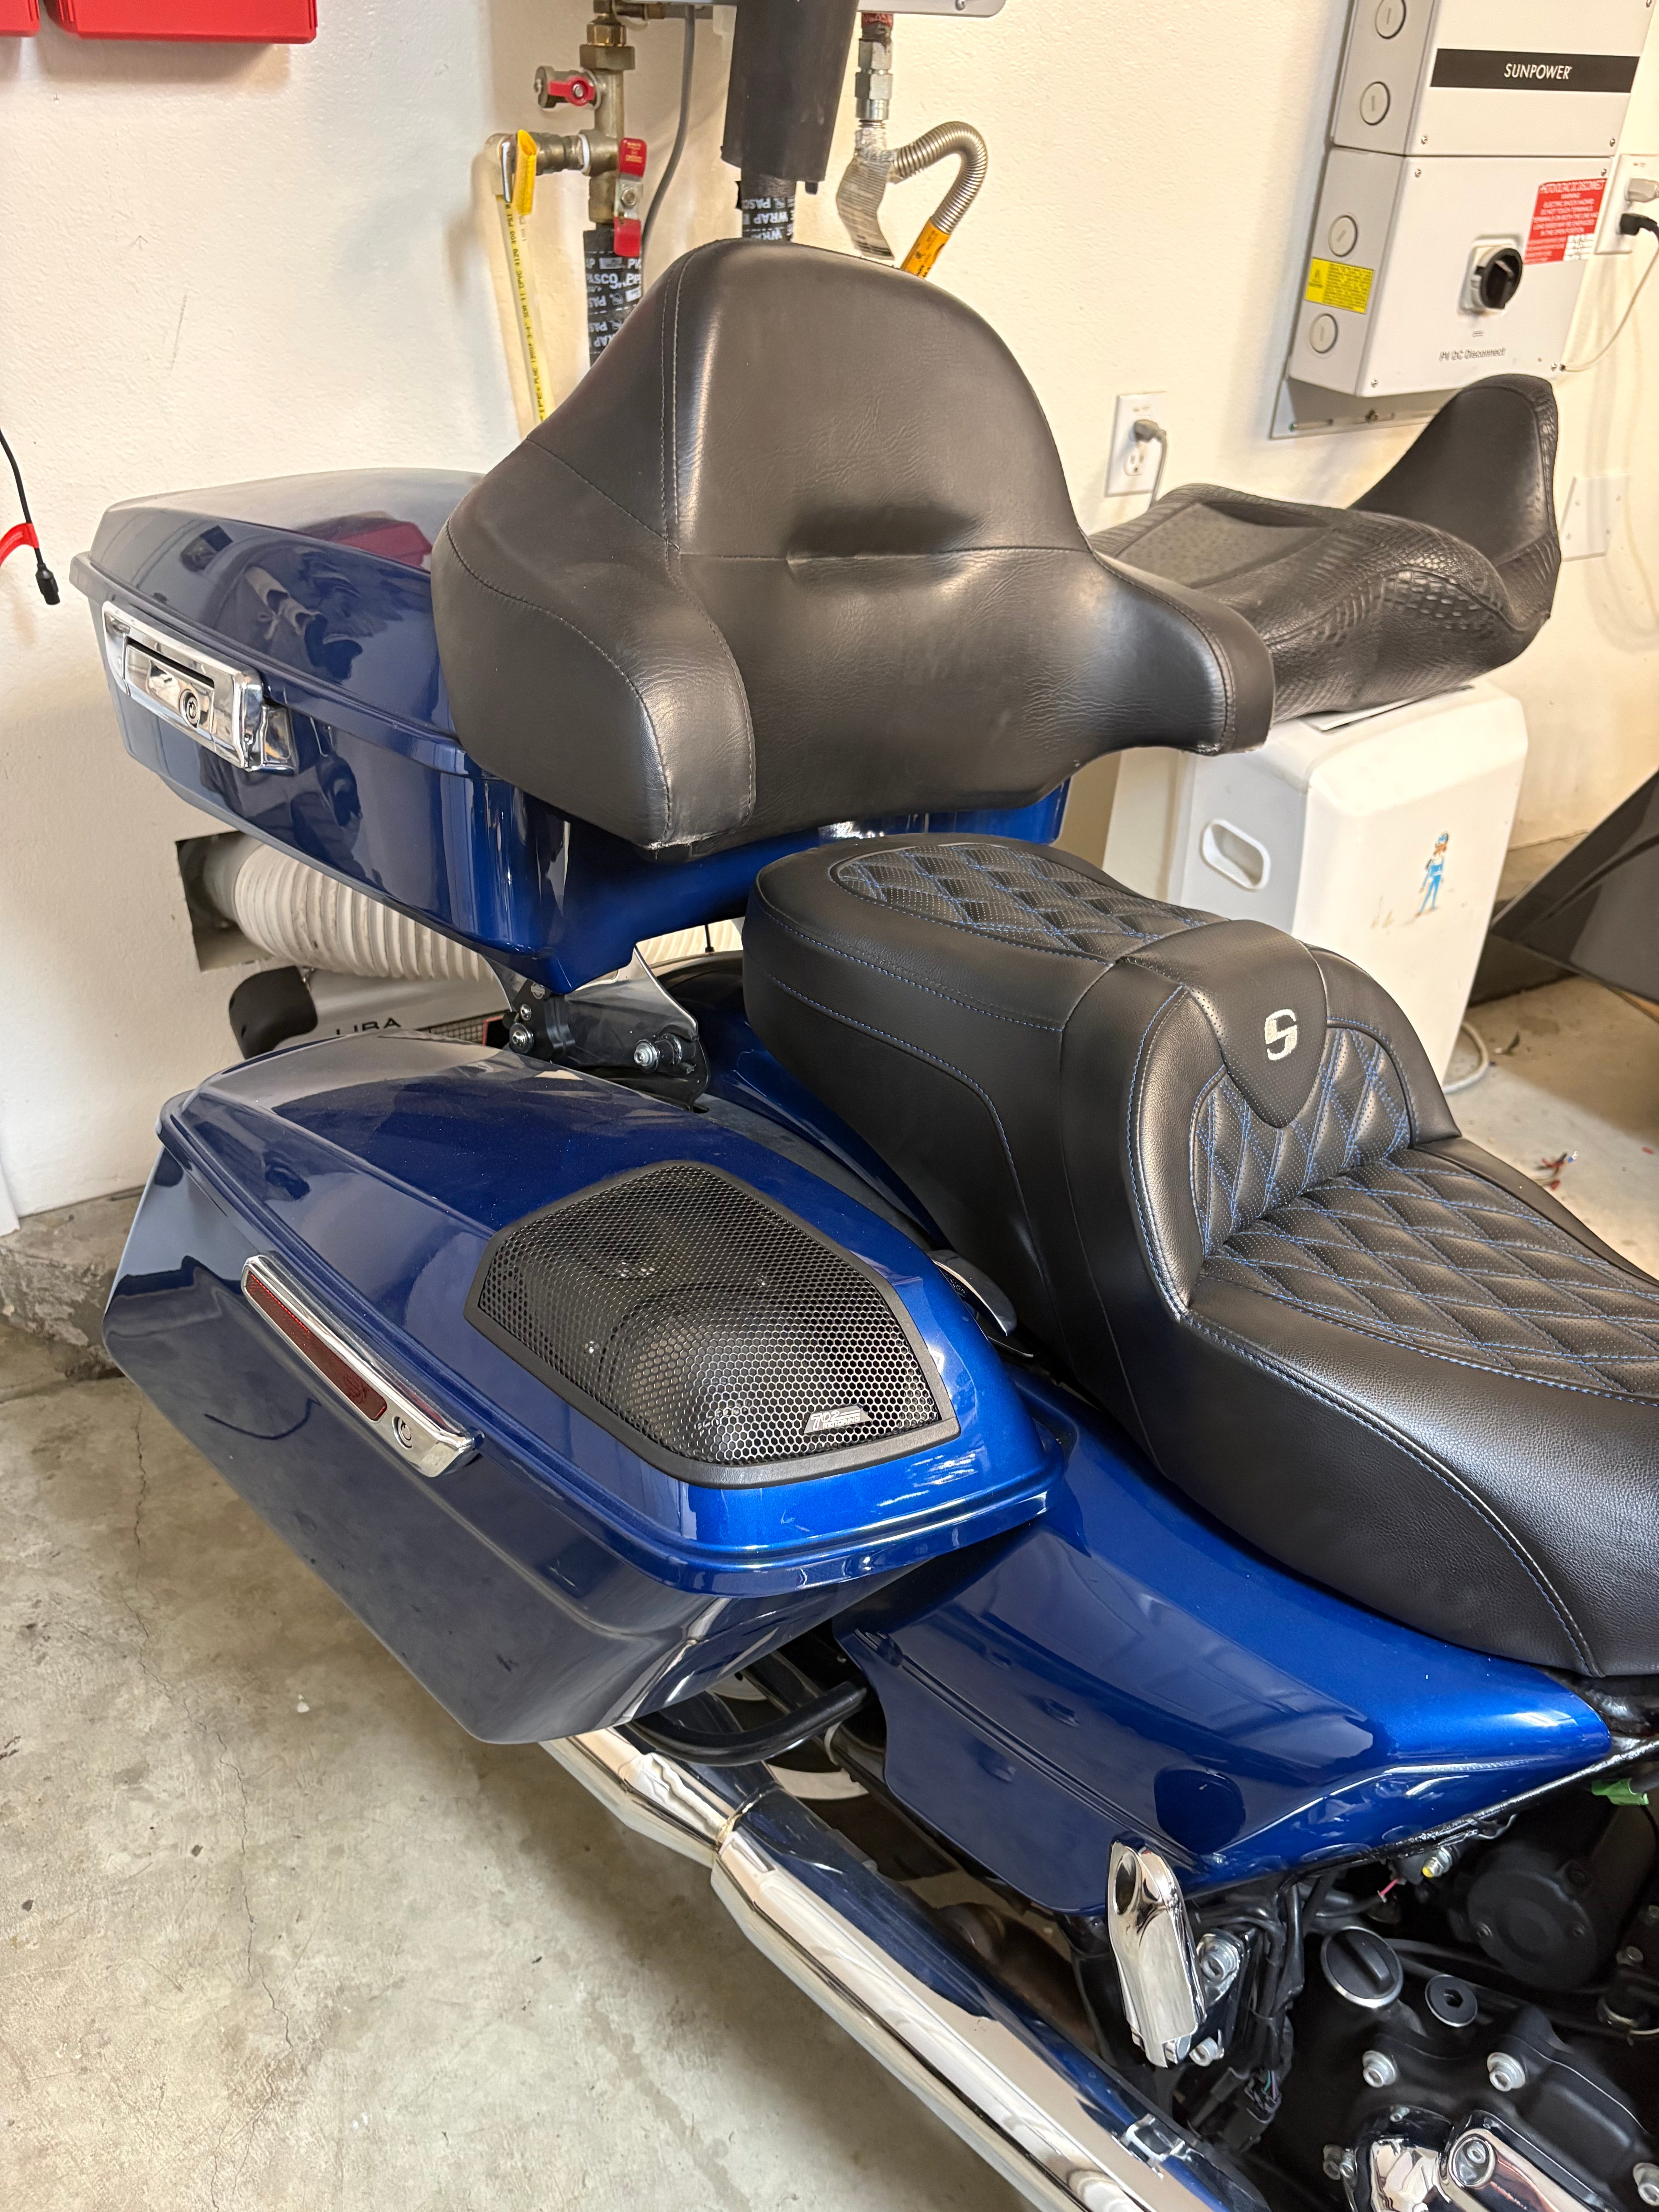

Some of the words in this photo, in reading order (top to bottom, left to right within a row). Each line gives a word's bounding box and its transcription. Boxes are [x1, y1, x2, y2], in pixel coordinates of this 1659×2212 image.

[1504, 63, 1571, 79] SUNPOWER
[753, 211, 788, 224] WRAP
[811, 1410, 840, 1431] 702
